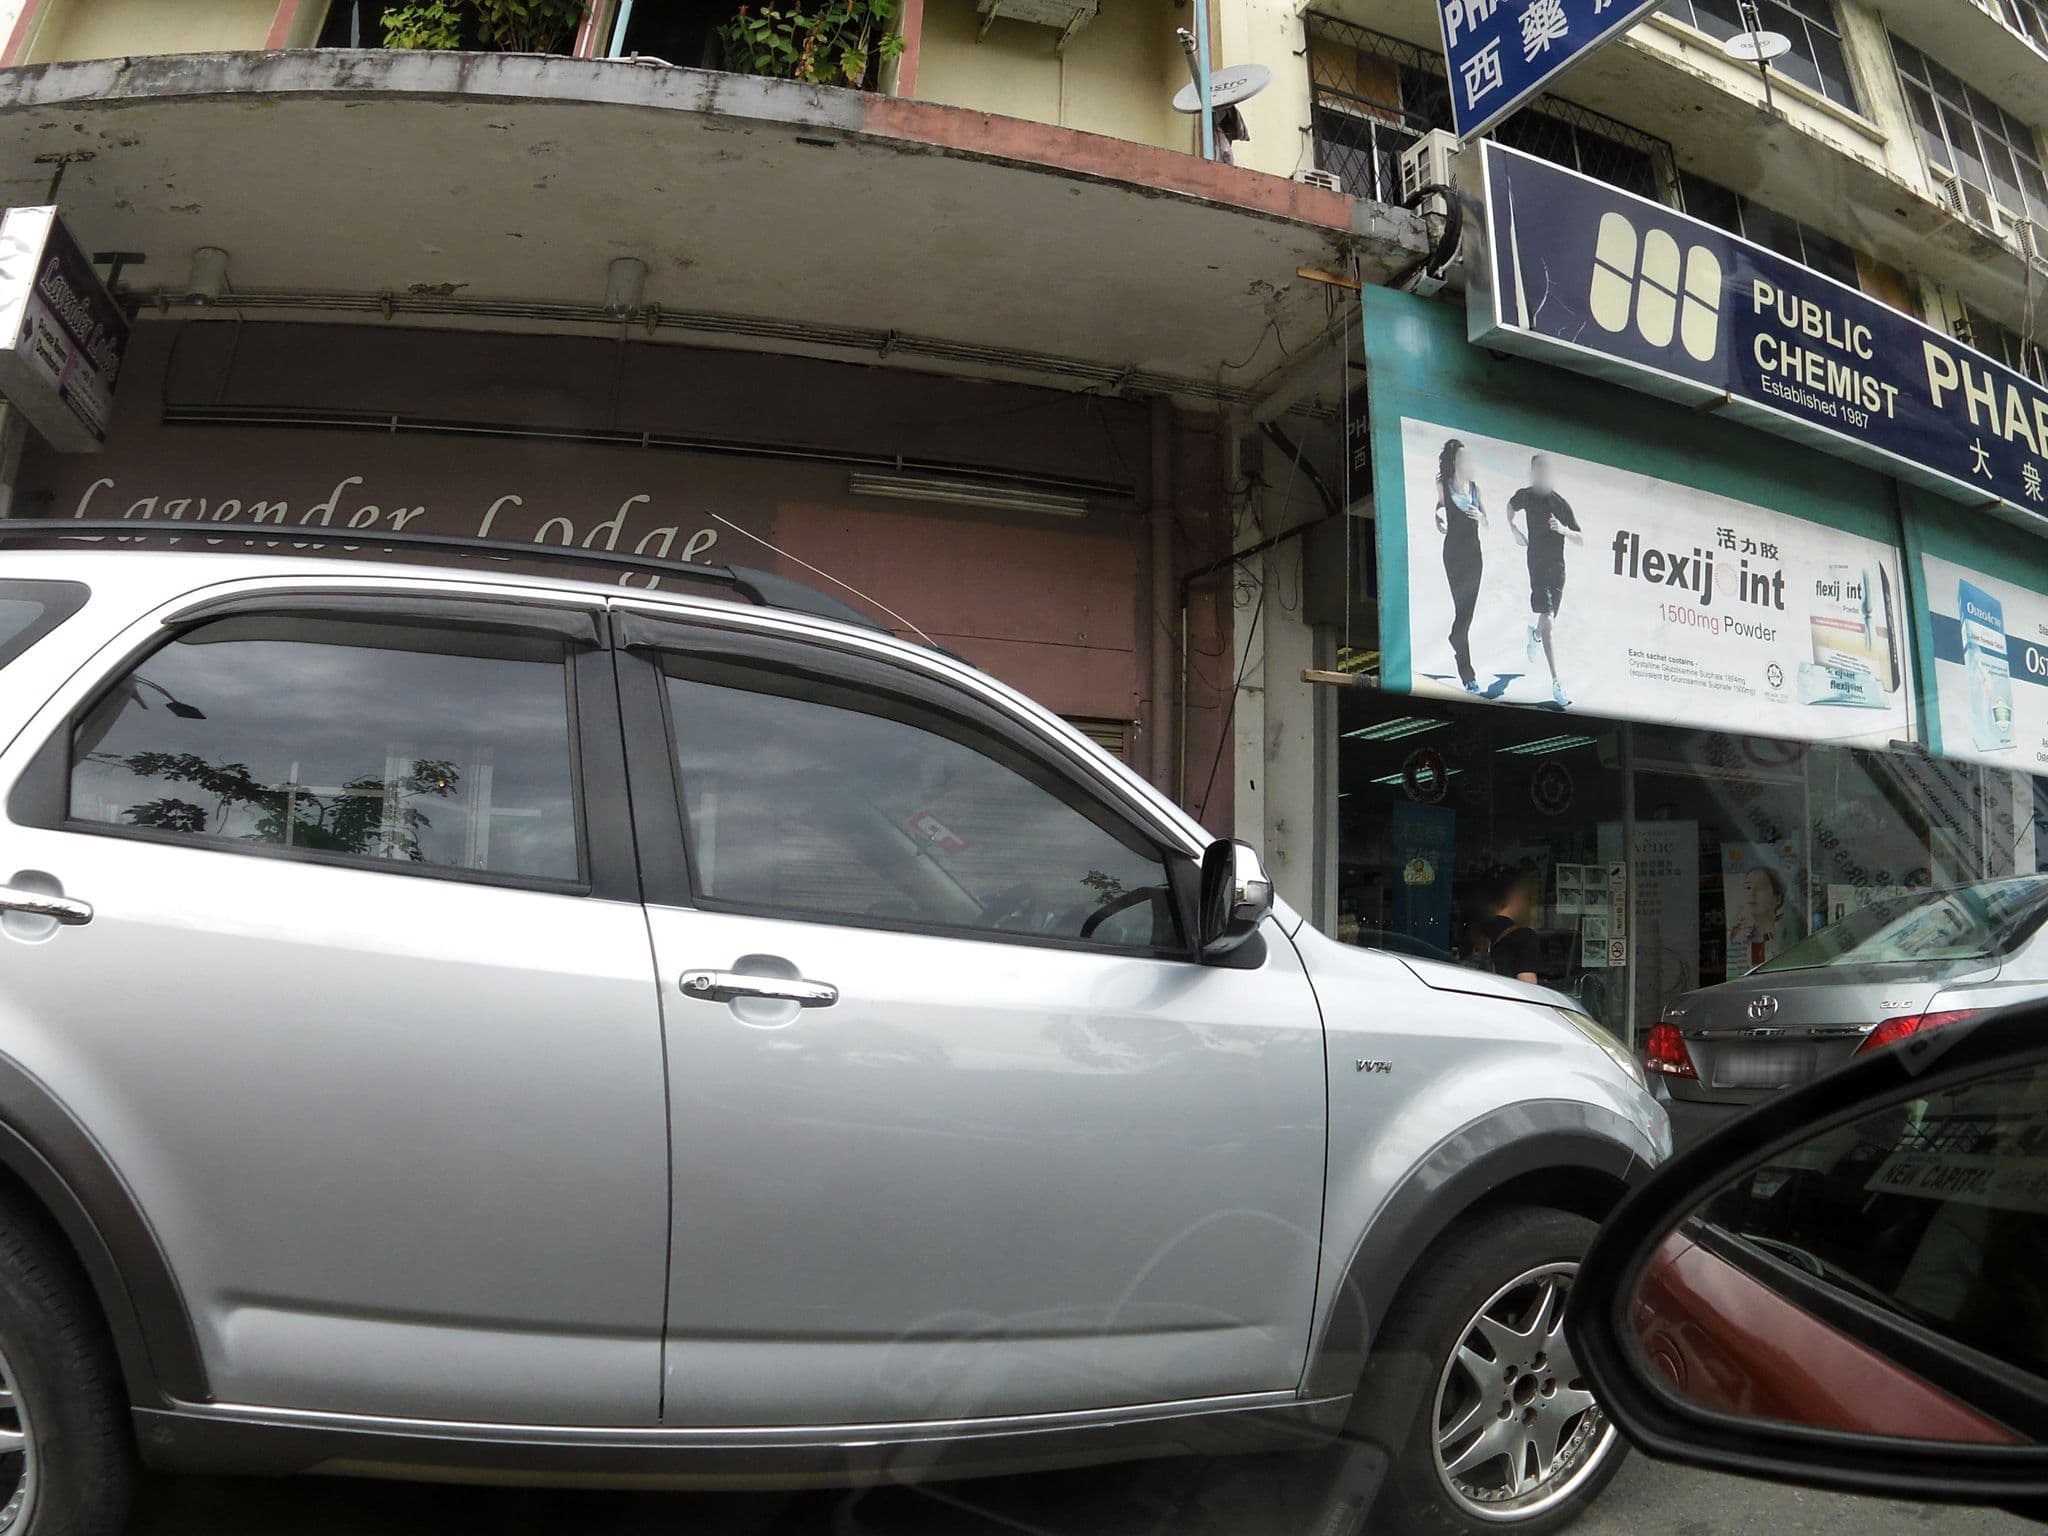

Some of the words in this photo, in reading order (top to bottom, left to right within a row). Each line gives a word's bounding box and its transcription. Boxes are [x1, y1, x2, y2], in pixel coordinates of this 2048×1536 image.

[1753, 279, 1874, 360] PUBLIC
[1754, 333, 1899, 420] CHEMIST
[1761, 374, 1838, 418] Established
[1840, 405, 1869, 430] 1987
[459, 494, 718, 591] Lodge
[1716, 526, 1780, 561] 活力胶
[1659, 602, 1720, 636] 1500mg
[1723, 615, 1777, 642] Powder
[1628, 648, 1645, 658] Each
[1645, 652, 1667, 662] sachet
[1667, 656, 1694, 667] contains
[1661, 663, 1698, 676] Glucosamine
[1670, 674, 1707, 688] Glucosamine
